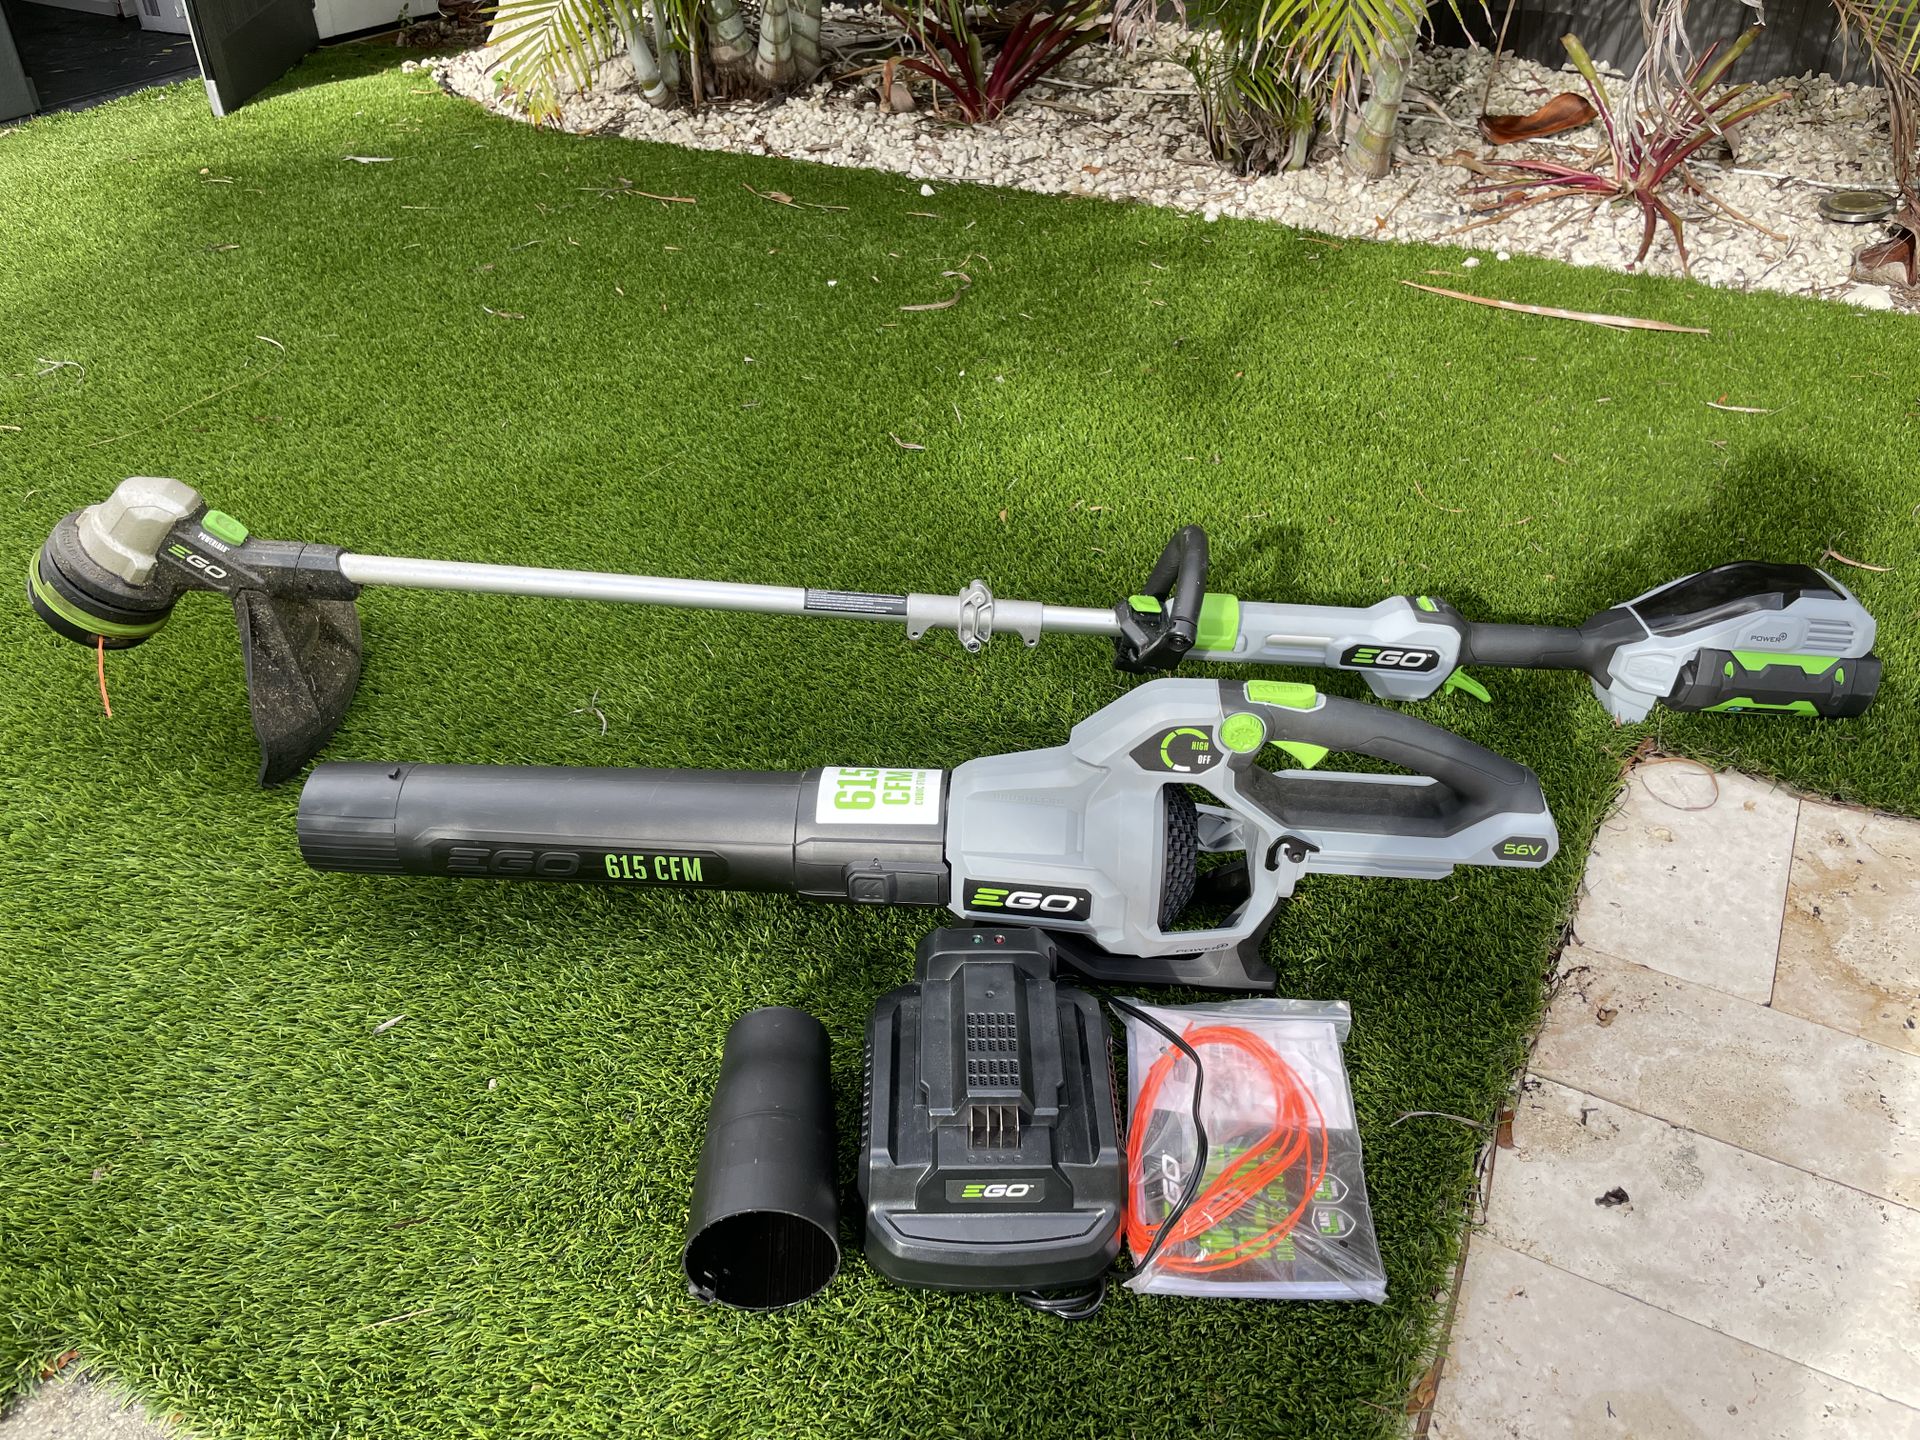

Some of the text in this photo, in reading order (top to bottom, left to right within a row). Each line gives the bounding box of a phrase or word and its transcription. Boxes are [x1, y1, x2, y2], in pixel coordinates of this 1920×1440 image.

[168, 543, 228, 579] EGO
[1351, 648, 1429, 668] EGO
[1191, 741, 1209, 751] HIGH
[1197, 755, 1212, 765] OFF
[882, 771, 913, 805] CFM
[1503, 843, 1543, 856] 56V
[448, 847, 581, 876] EGO
[605, 853, 704, 882] 615 CFM
[971, 887, 1078, 913] EGO
[961, 1183, 1030, 1198] EGO
